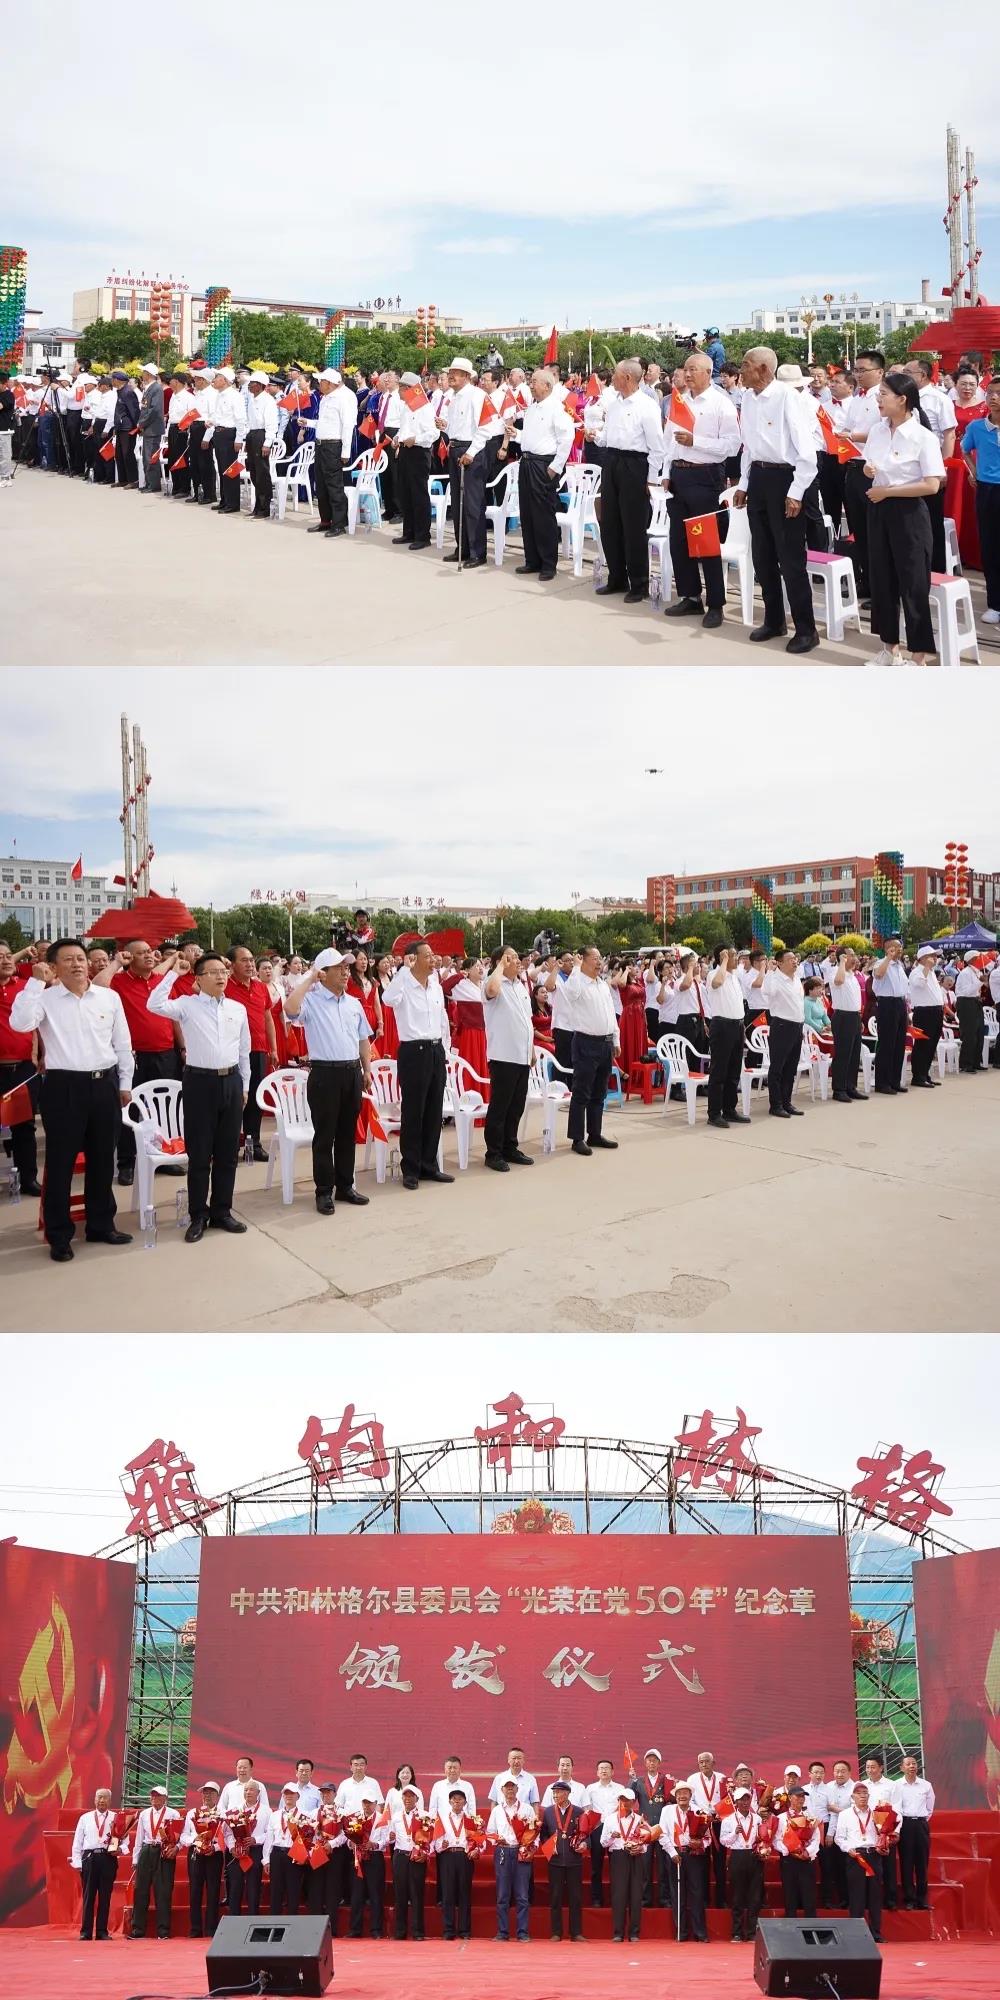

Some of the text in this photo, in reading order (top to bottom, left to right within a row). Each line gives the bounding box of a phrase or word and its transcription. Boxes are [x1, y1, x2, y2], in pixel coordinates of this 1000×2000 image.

[106, 276, 190, 291] 矛盾纠纷化解联务中心
[338, 1638, 706, 1695] 颁发仪式
